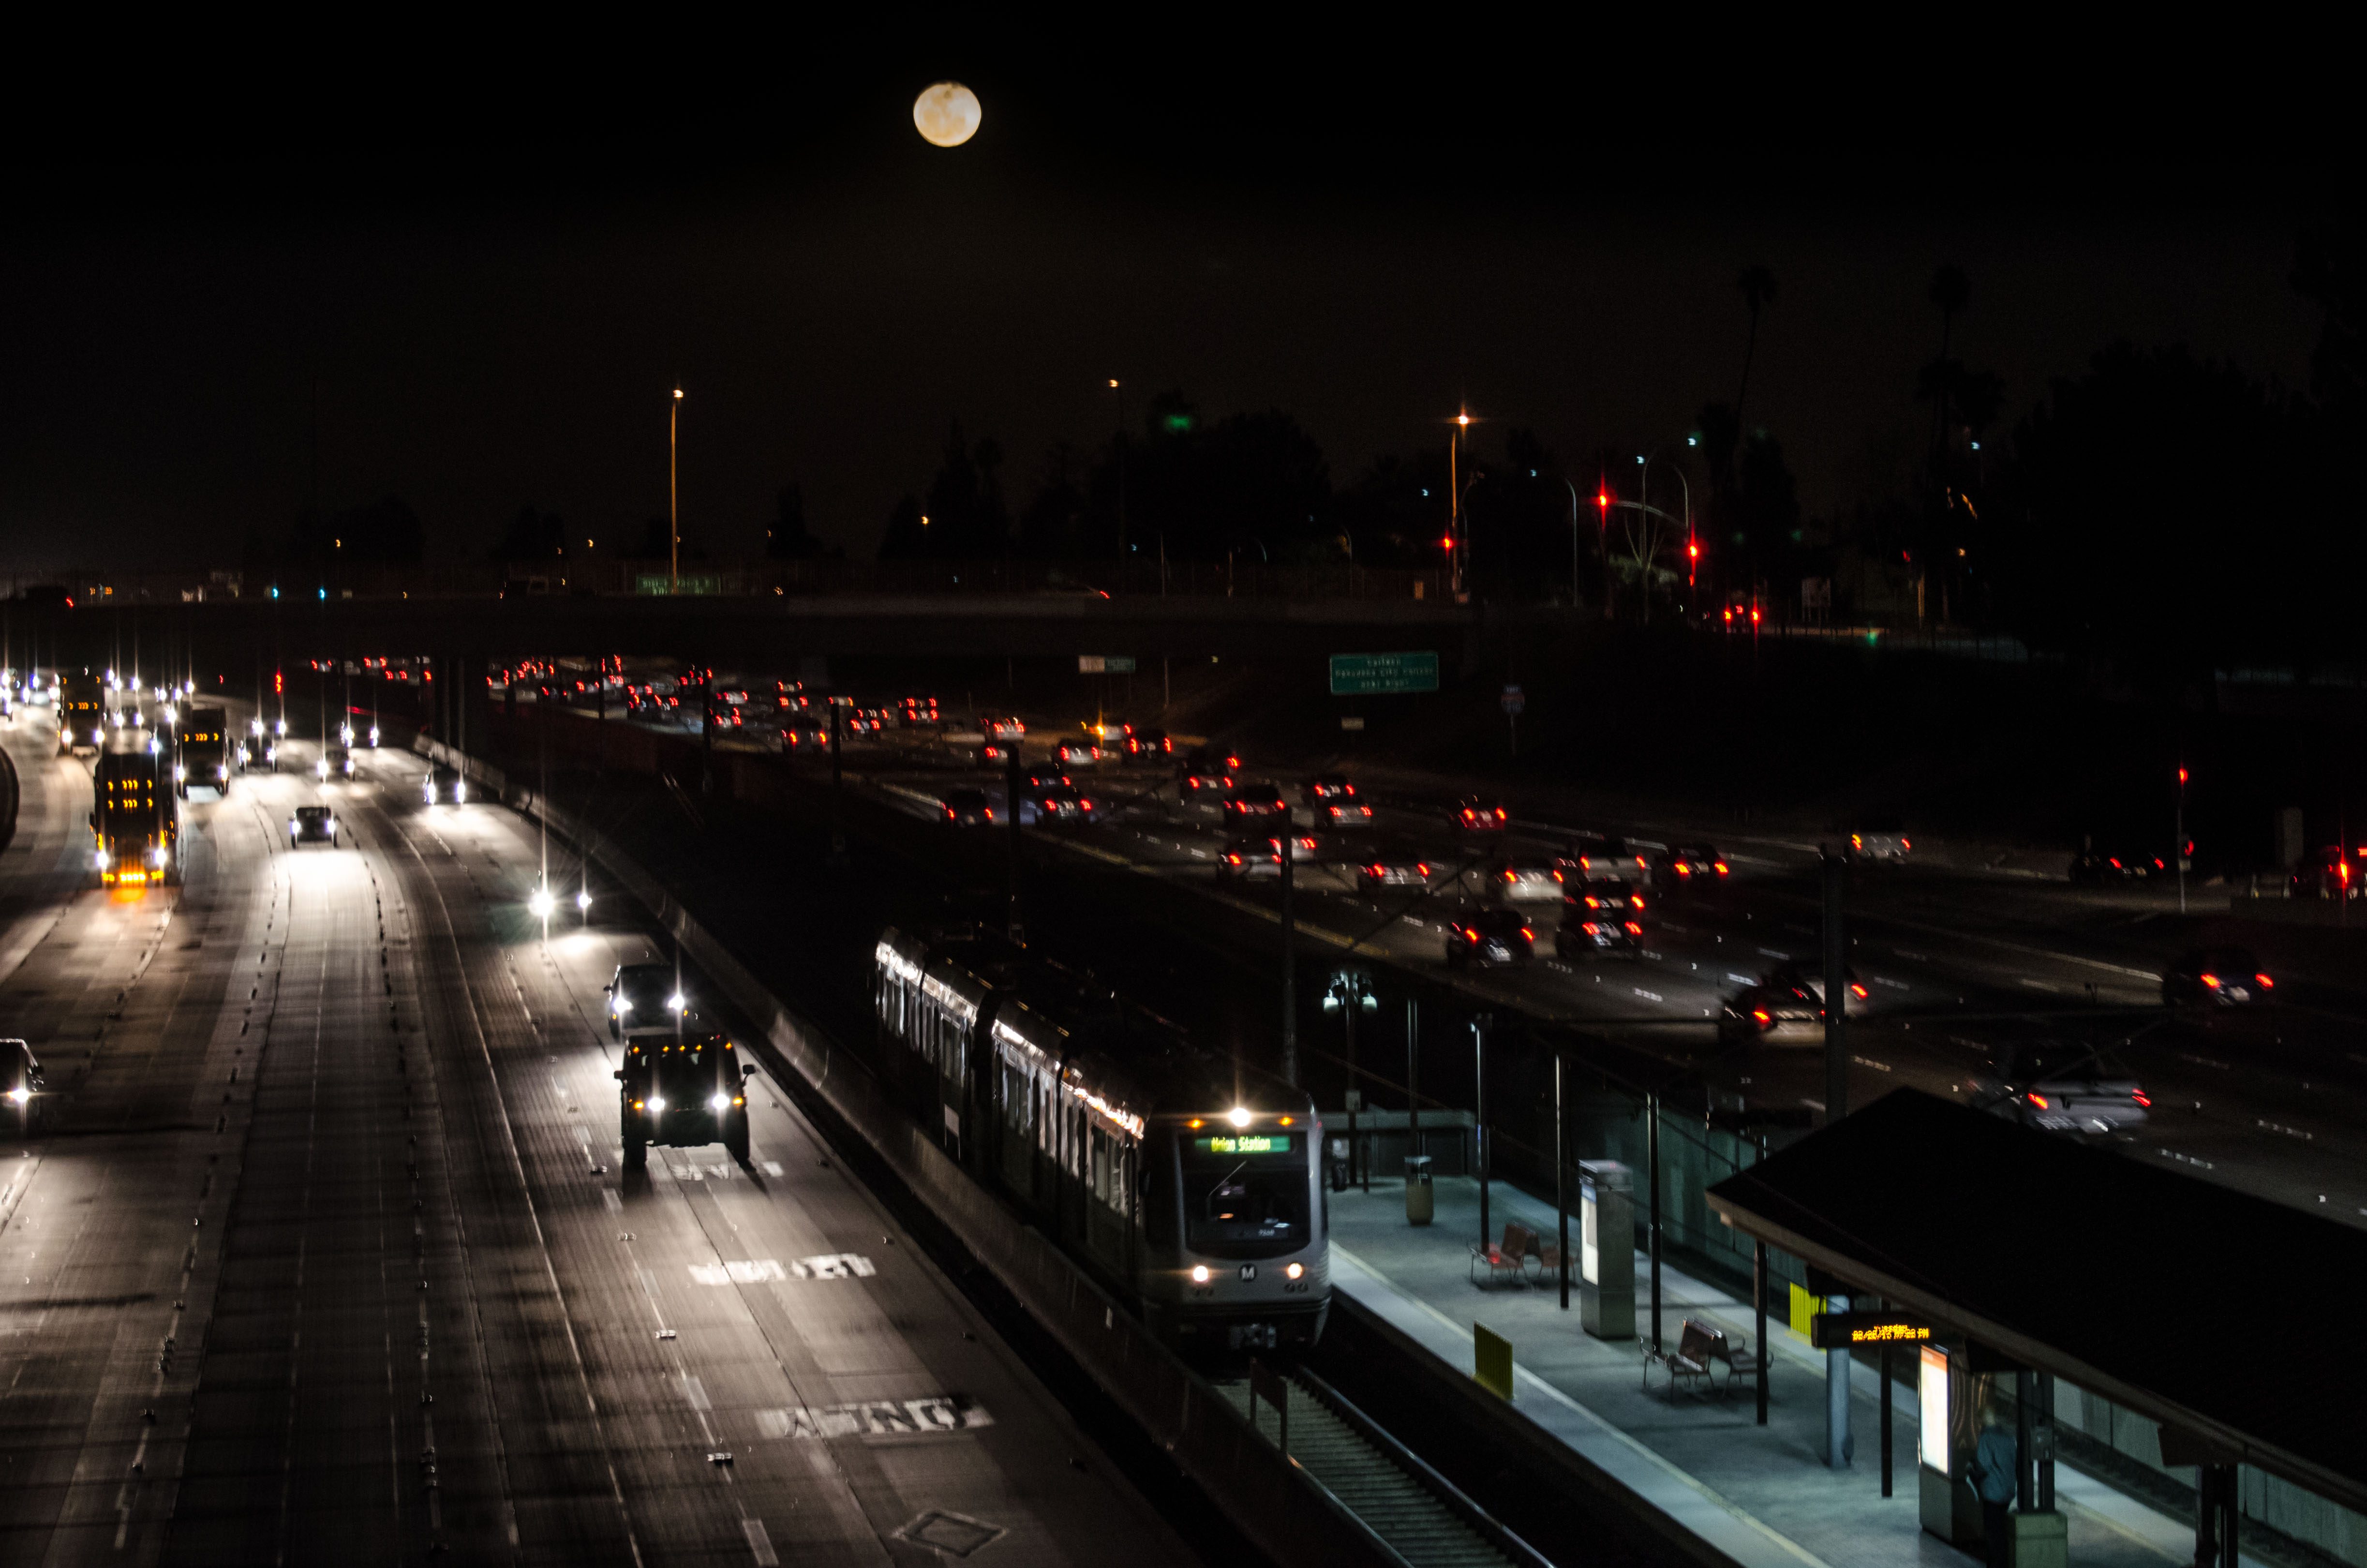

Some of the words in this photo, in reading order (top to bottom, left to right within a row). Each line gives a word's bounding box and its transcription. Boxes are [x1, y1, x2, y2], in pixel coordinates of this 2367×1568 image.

[1211, 1137, 1236, 1151] Union
[1238, 1136, 1271, 1151] Station
[1242, 1267, 1255, 1280] M
[1918, 1328, 1930, 1339] PM
[776, 1398, 972, 1438] ONLY
